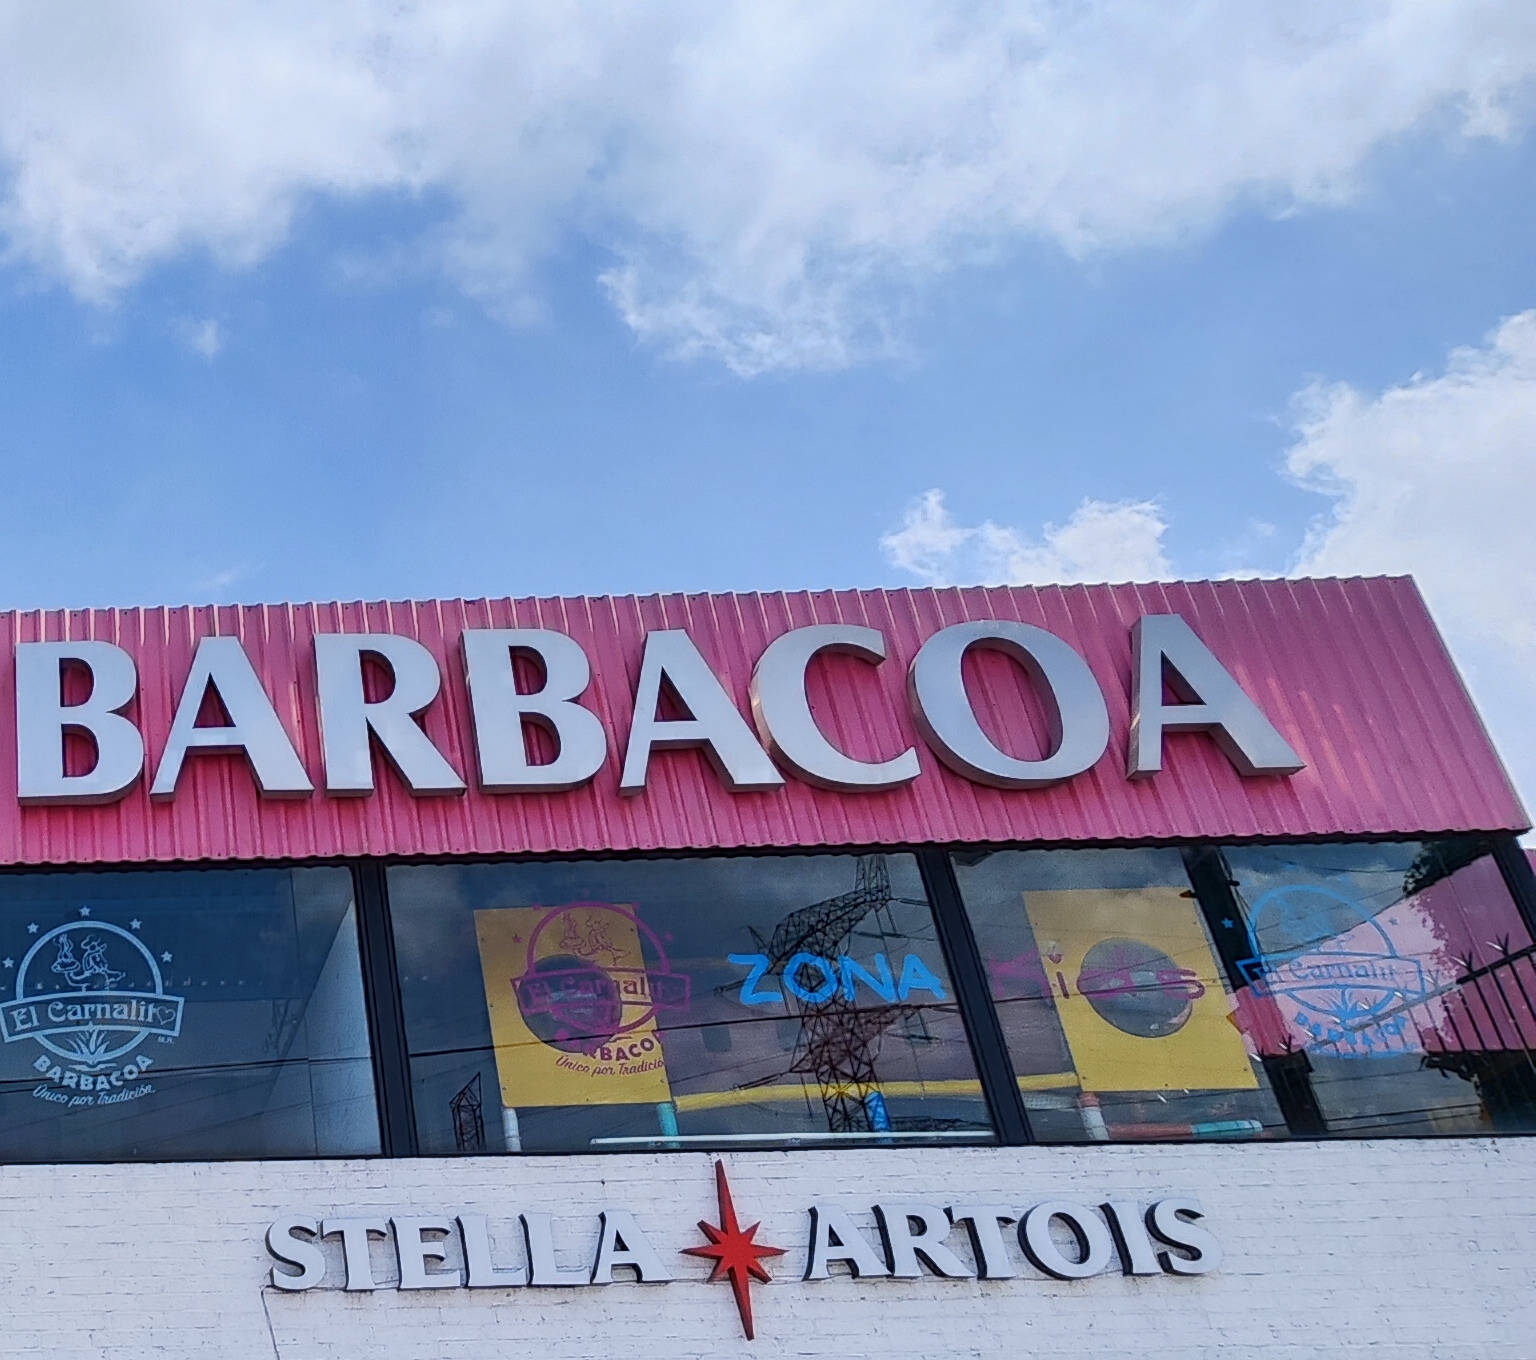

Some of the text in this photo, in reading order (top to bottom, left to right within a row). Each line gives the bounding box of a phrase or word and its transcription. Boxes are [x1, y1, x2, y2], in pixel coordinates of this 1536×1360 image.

[15, 614, 1305, 806] BARBACOA
[727, 952, 949, 1005] ZONA
[9, 1006, 40, 1031] El
[33, 1054, 154, 1091] BARBACOA
[591, 1064, 616, 1077] por
[68, 1094, 95, 1108] por
[264, 1196, 1224, 1293] STELLA ARTOIS
